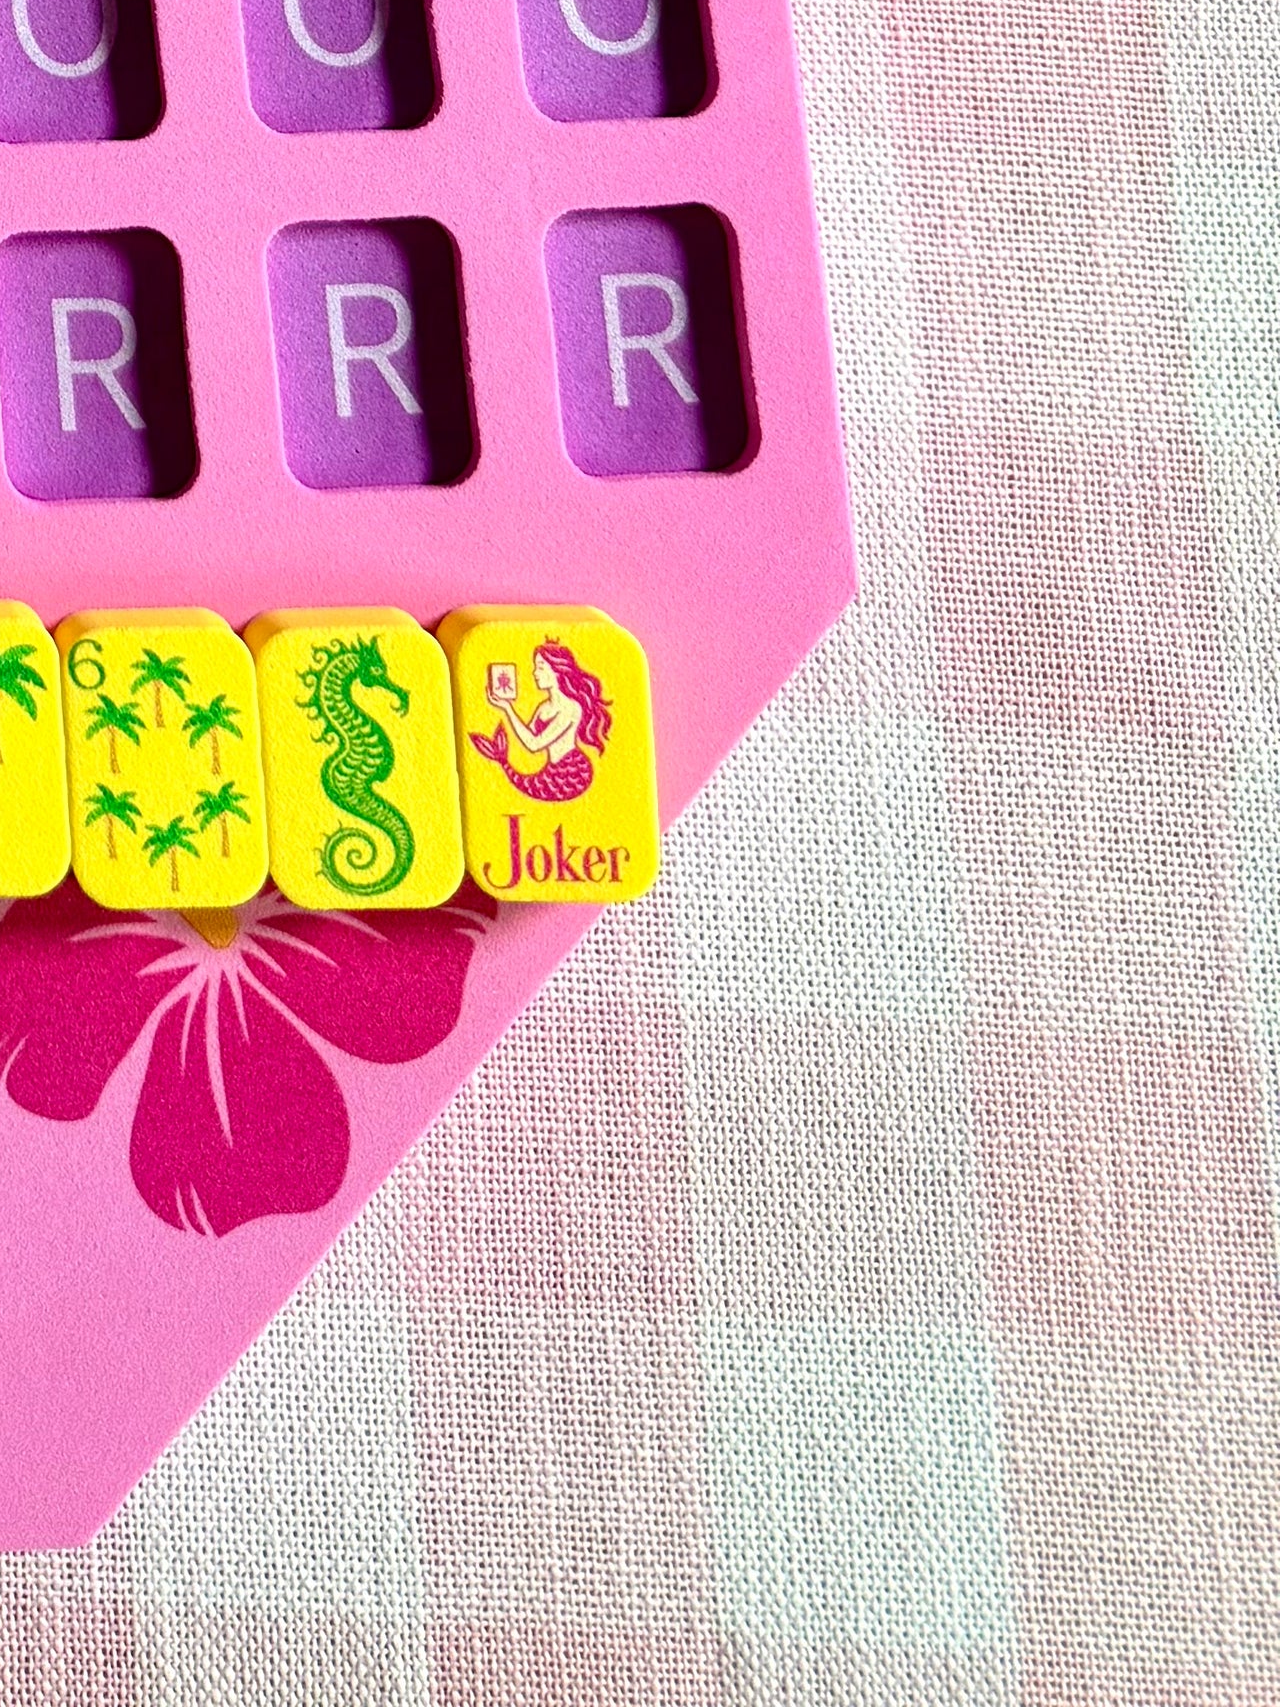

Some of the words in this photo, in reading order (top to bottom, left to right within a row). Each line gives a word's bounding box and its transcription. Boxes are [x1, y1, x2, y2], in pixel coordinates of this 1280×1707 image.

[50, 297, 147, 433] R
[325, 282, 423, 418] R
[600, 272, 699, 408] R
[67, 639, 107, 690] 6
[484, 813, 632, 890] Joker
